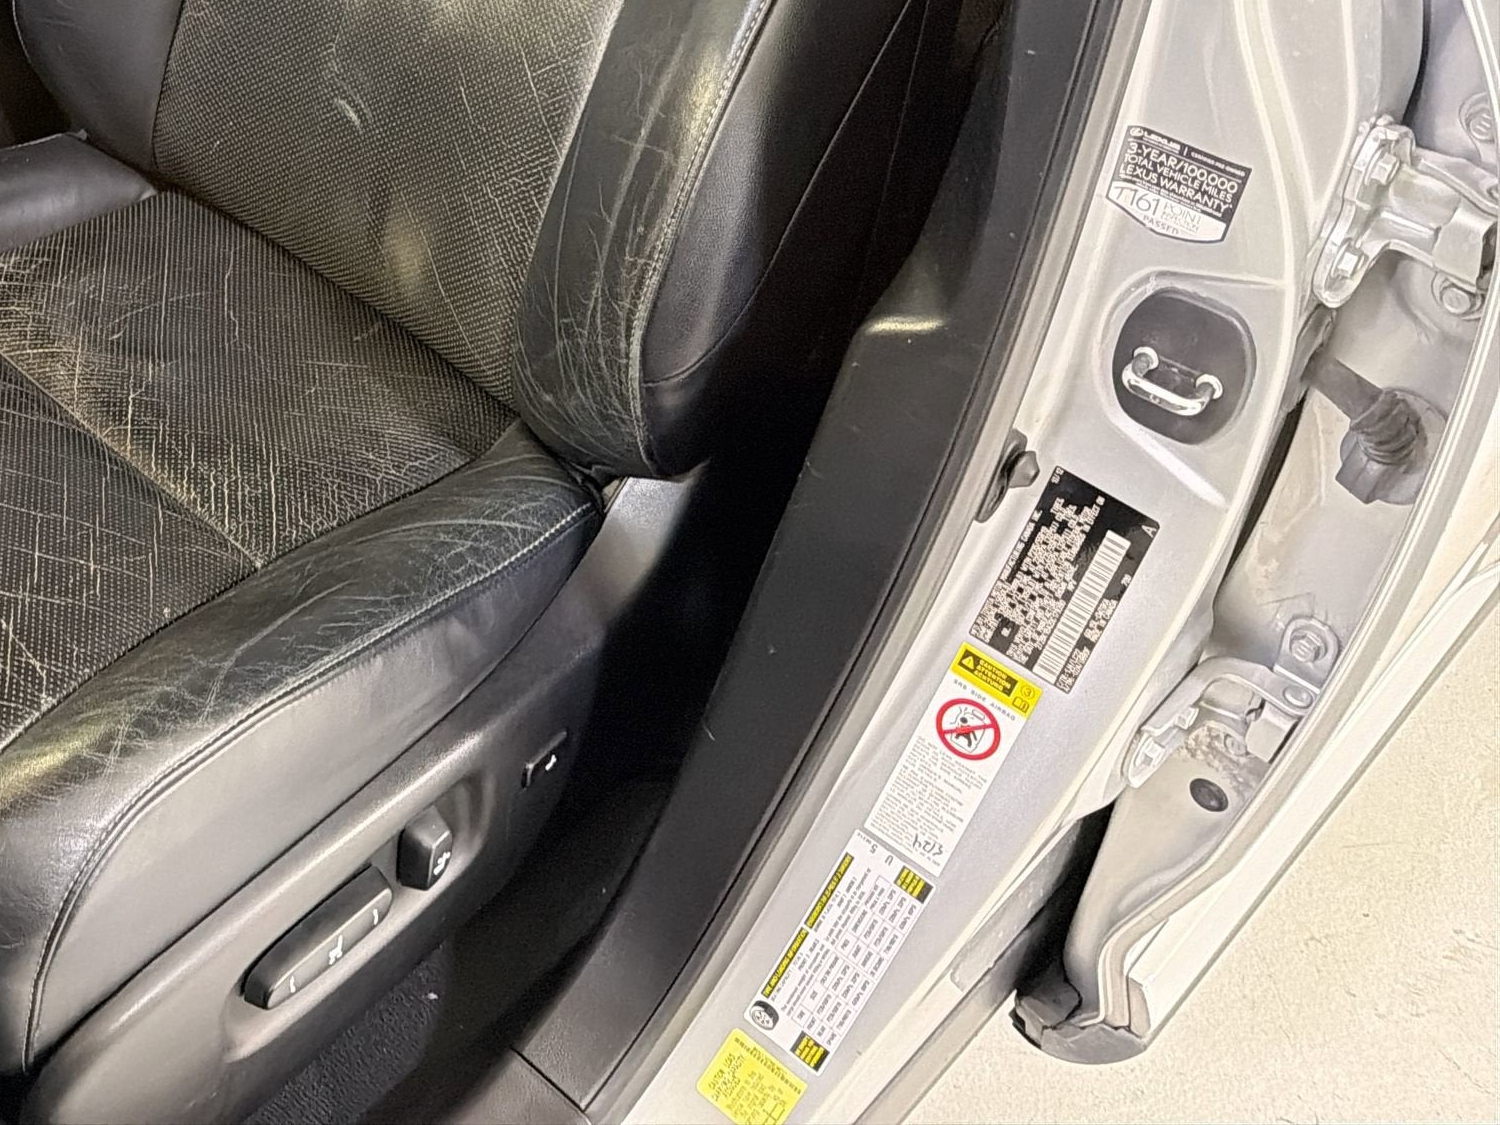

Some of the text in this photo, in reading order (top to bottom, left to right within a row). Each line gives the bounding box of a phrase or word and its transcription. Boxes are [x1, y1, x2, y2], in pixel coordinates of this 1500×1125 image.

[1119, 162, 1158, 184] LEXUS
[1122, 152, 1155, 170] TOTAL
[1155, 163, 1200, 189] VEHICLE
[1201, 183, 1233, 203] MILES
[1126, 142, 1237, 193] 3-YEAR/100,000
[1141, 214, 1179, 235] PASSED
[1139, 522, 1157, 538] A
[972, 669, 1003, 691] ACHTUNG
[975, 664, 1011, 689] ATTENTION
[978, 659, 1007, 680] CAUTION
[989, 701, 1016, 721] AIRBAG
